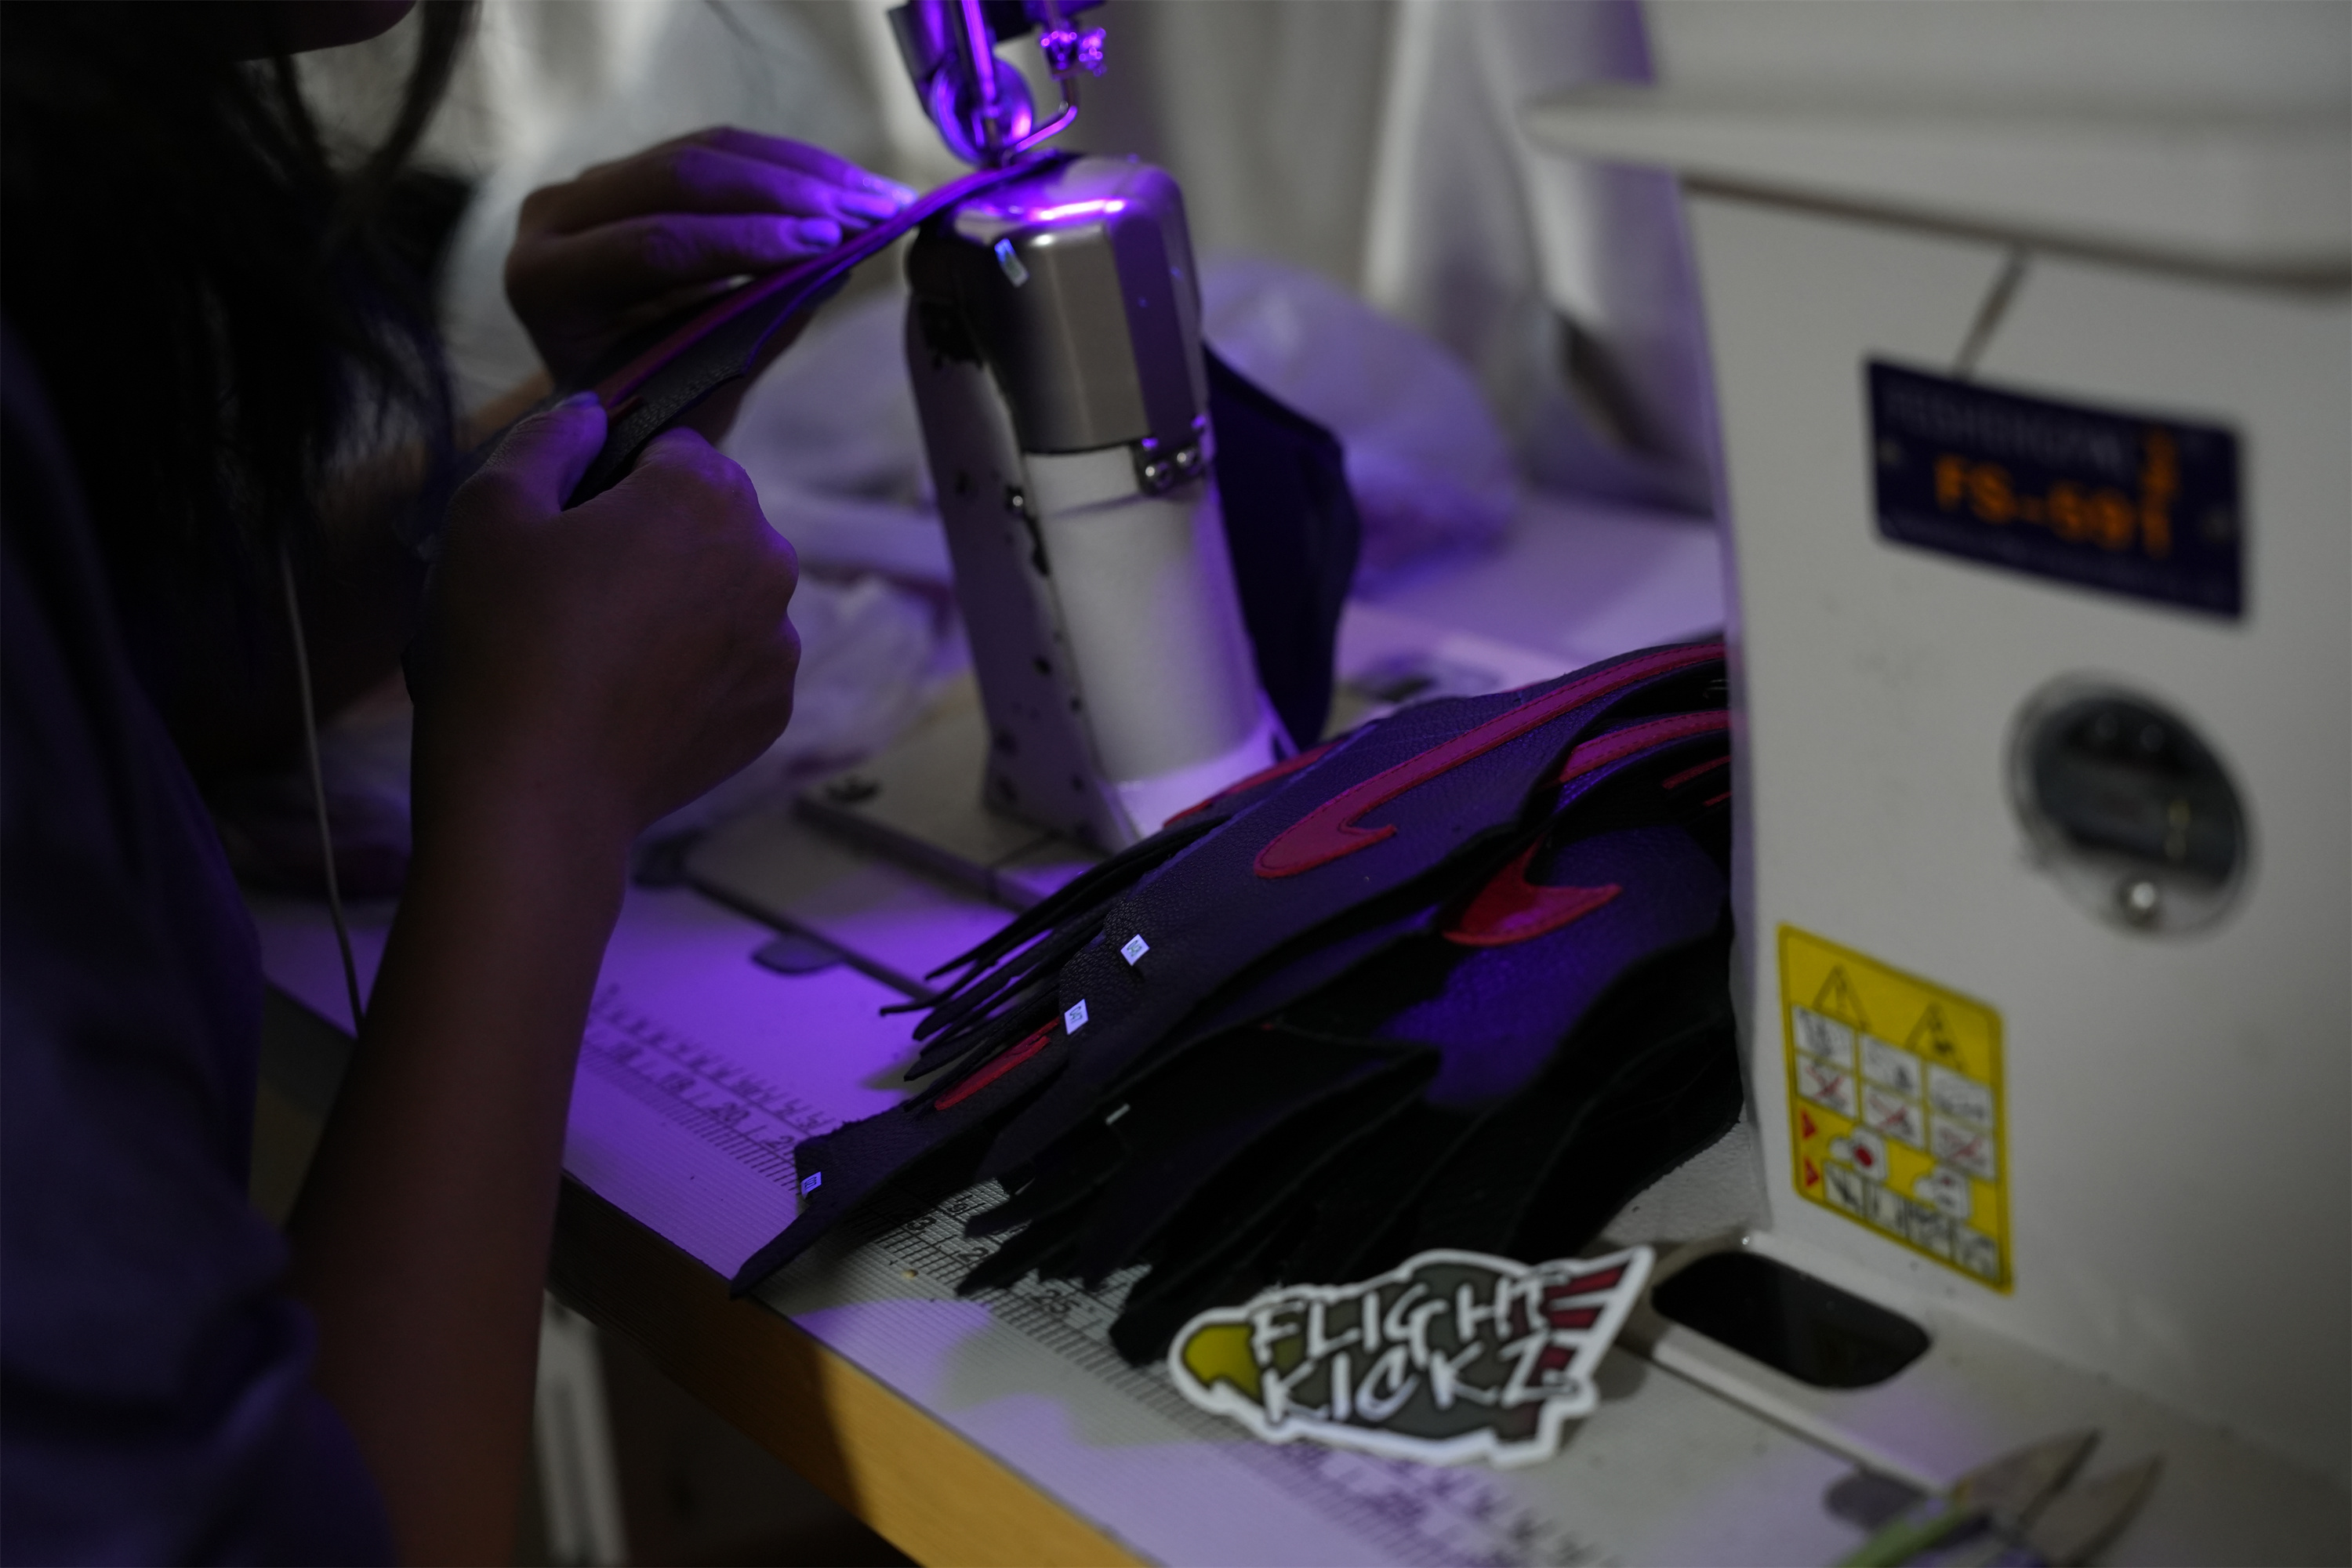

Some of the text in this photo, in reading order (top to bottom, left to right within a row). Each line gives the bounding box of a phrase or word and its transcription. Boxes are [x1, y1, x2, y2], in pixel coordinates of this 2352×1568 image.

[1032, 1289, 1081, 1314] 25
[1252, 1265, 1570, 1371] FLIGHT
[1261, 1333, 1585, 1423] KICKZ
